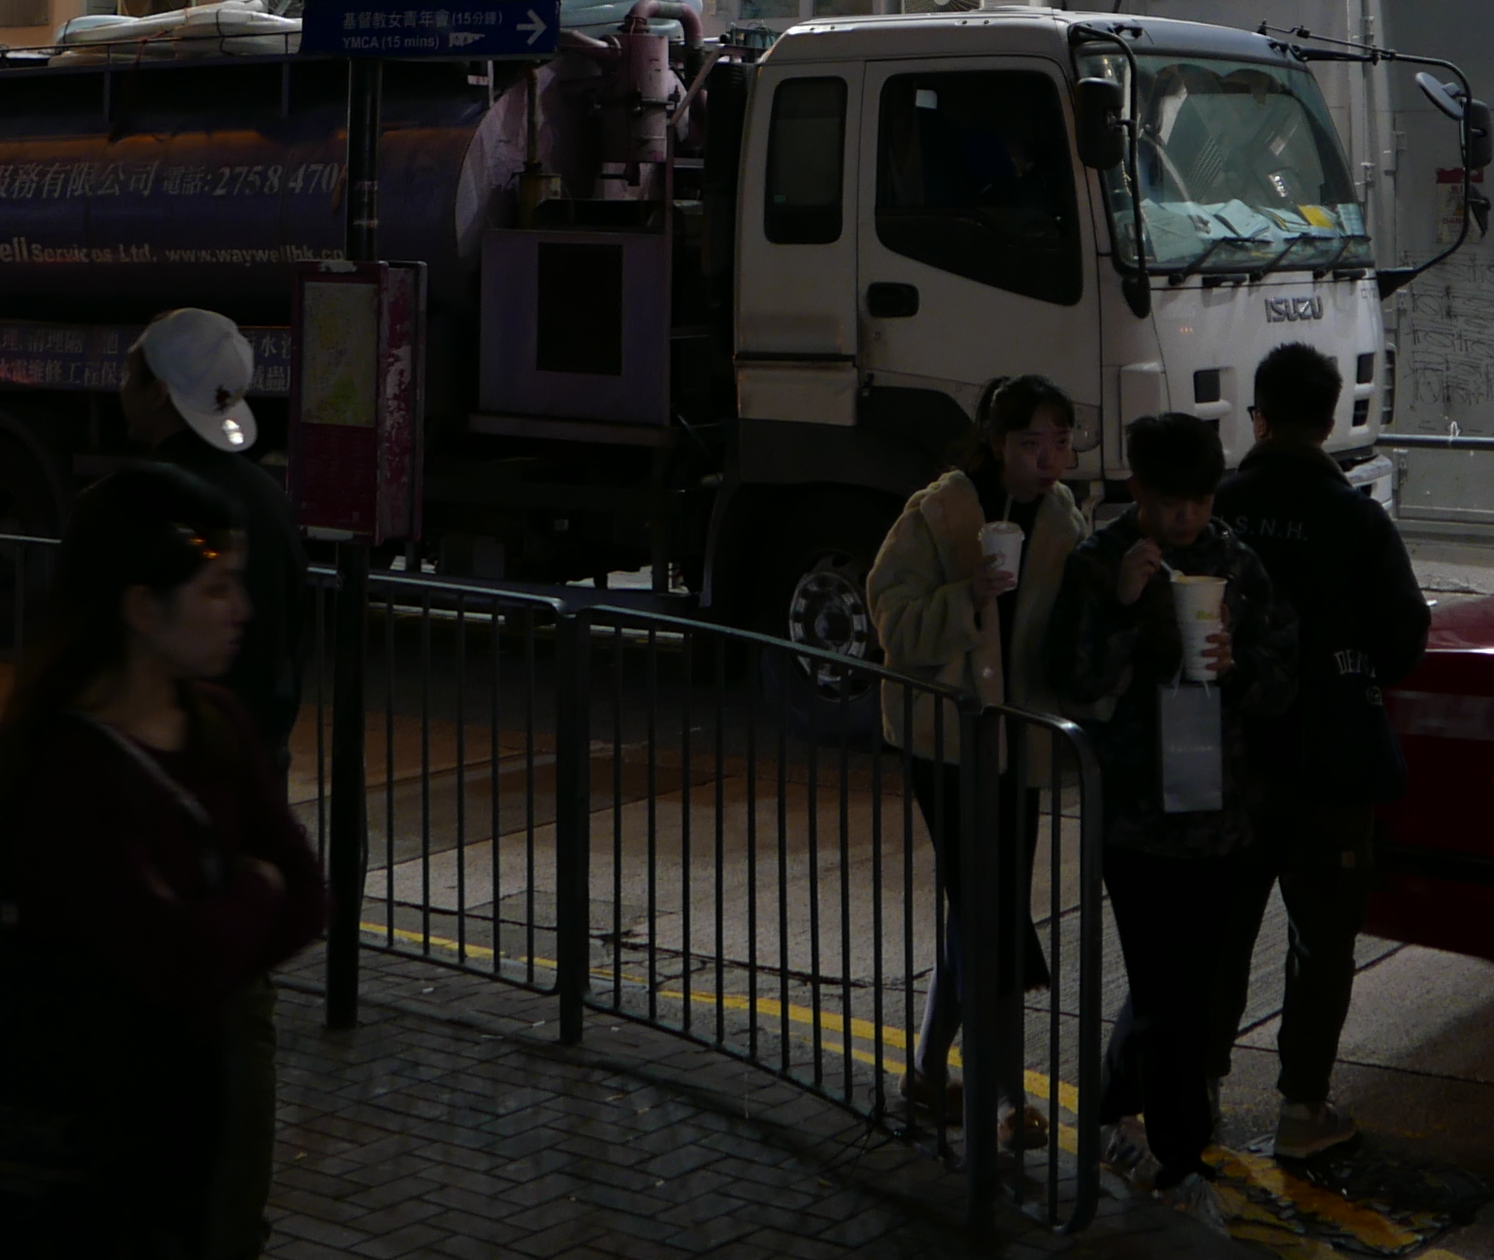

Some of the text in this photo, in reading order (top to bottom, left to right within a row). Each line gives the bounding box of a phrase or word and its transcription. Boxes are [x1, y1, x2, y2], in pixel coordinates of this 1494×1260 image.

[381, 34, 402, 51] (15
[404, 33, 439, 50] mins)
[119, 242, 157, 263] Ltd.
[166, 245, 345, 267] www.waywellhk.co
[1265, 296, 1323, 322] ISUZU
